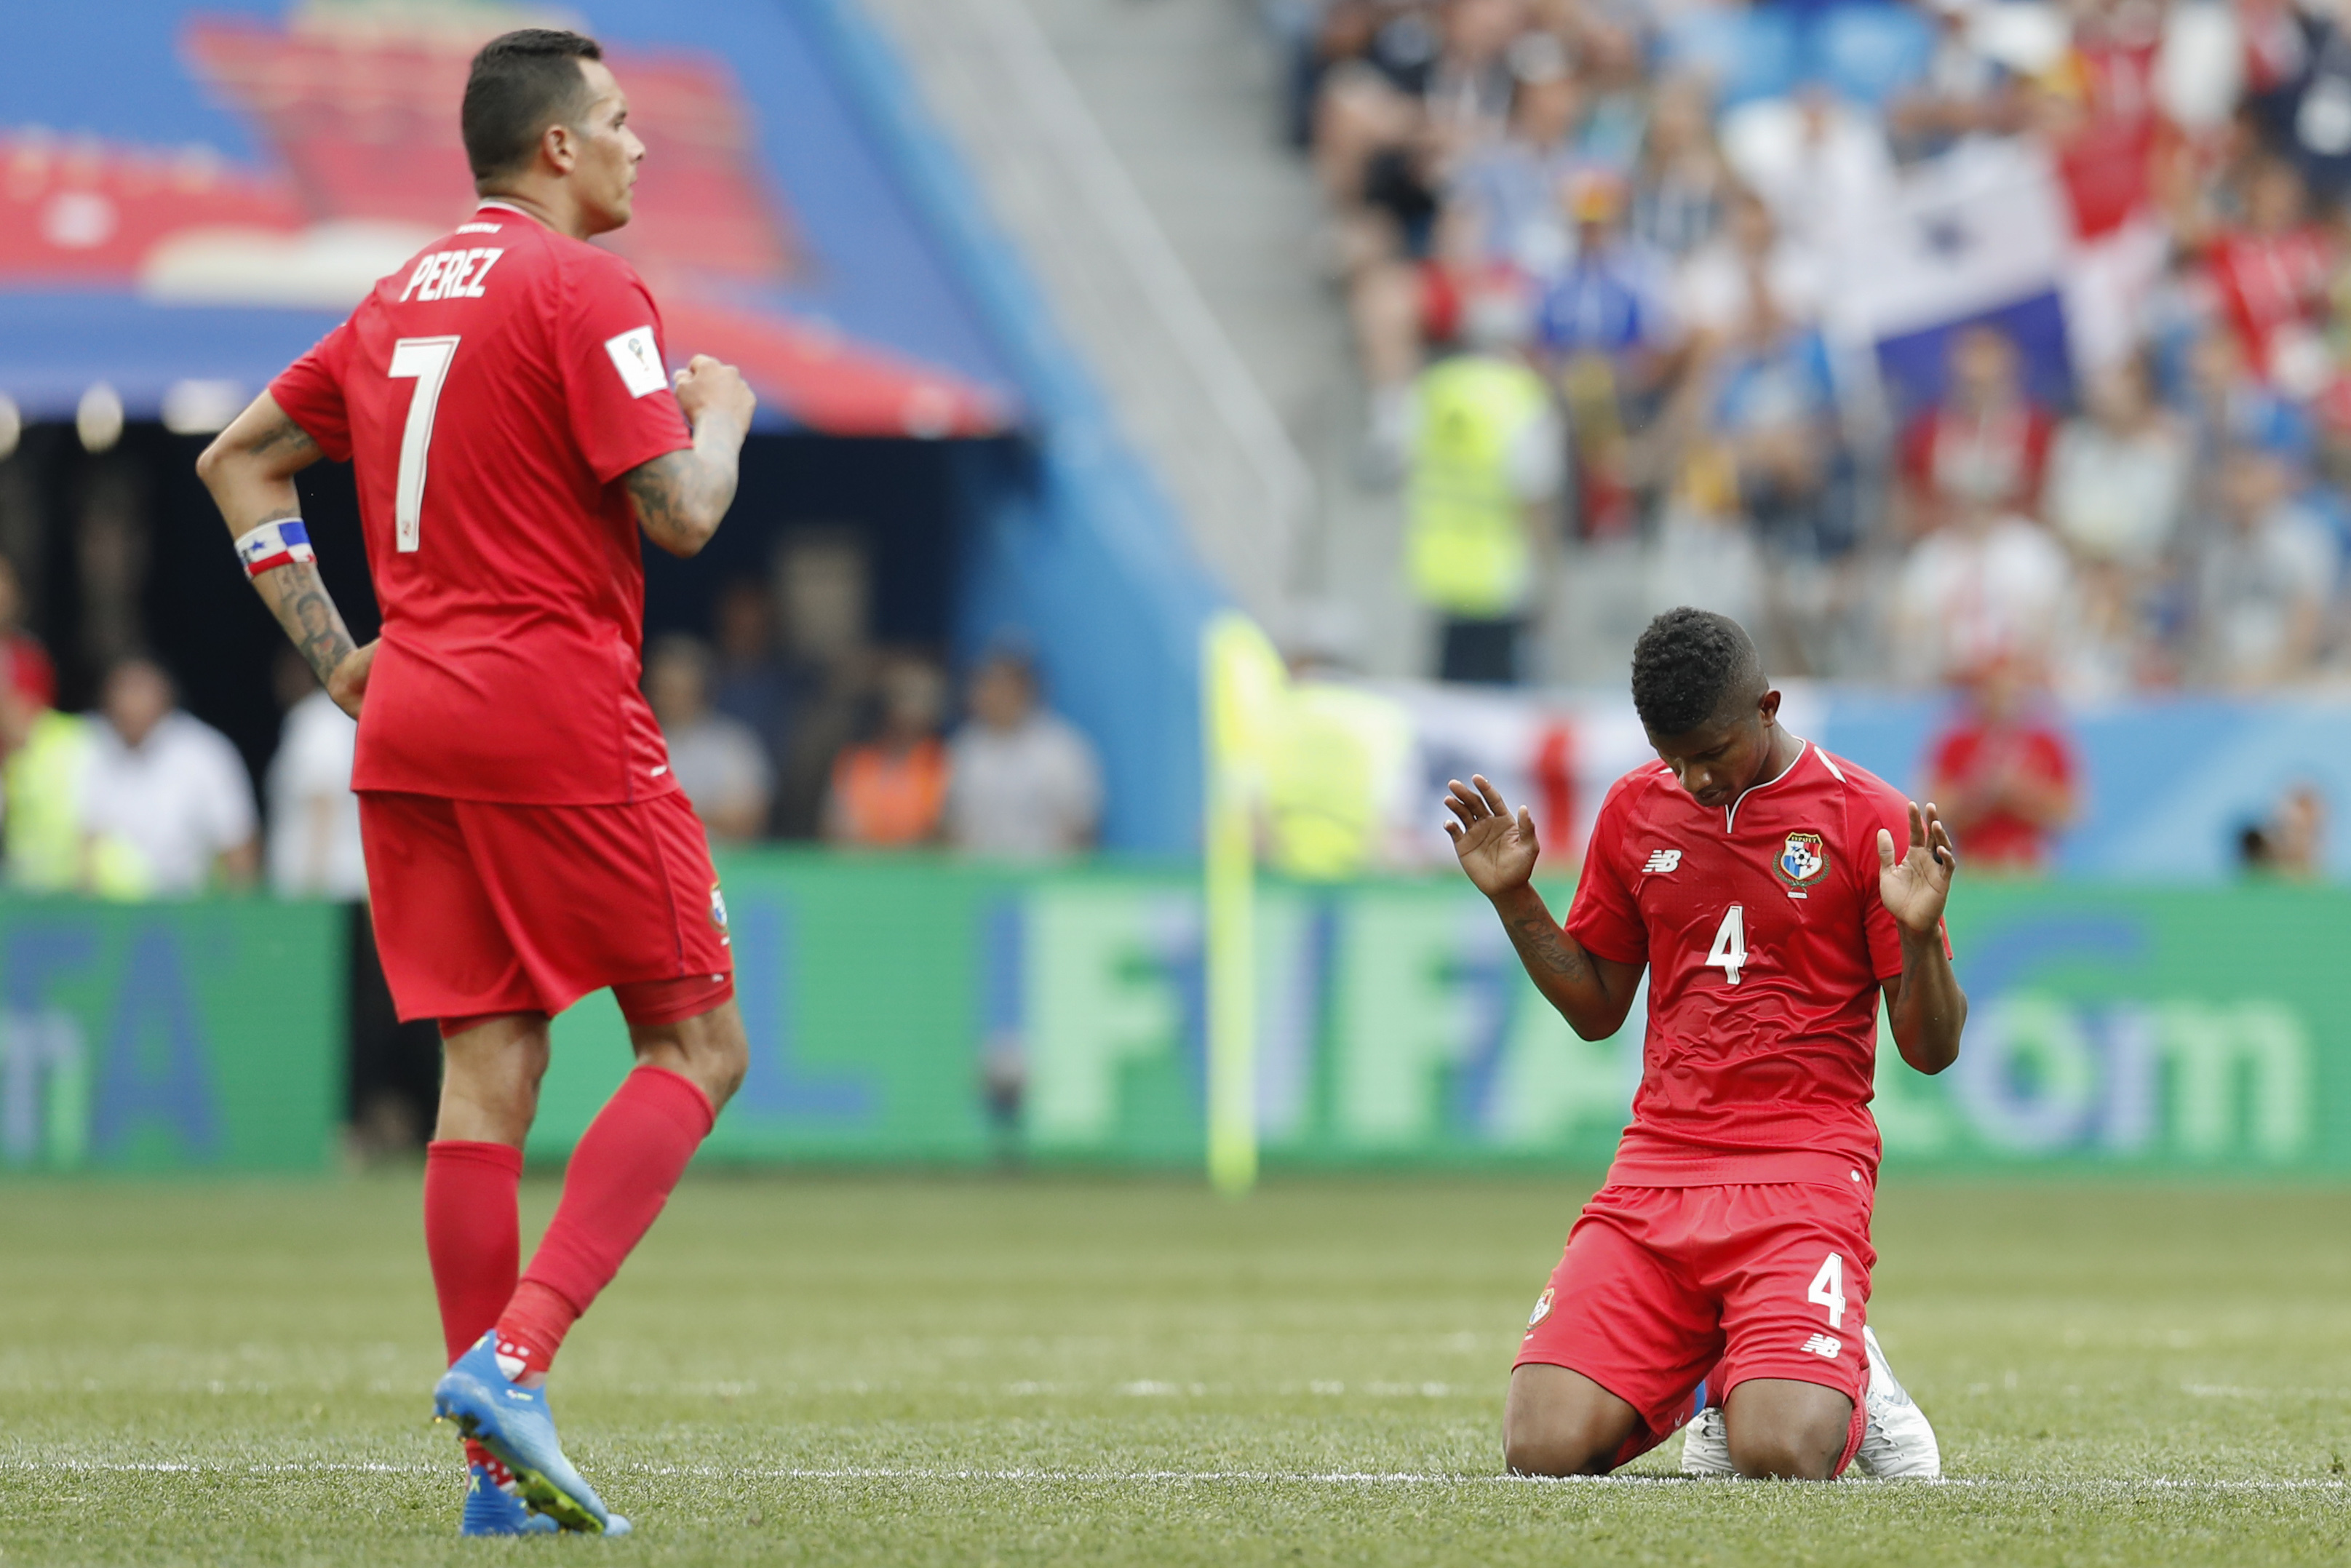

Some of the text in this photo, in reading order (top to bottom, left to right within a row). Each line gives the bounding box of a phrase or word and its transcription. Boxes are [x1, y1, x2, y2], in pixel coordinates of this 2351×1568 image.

[399, 247, 505, 303] PEREZ
[388, 334, 461, 553] 7
[1642, 849, 1682, 873] NB
[1705, 905, 1749, 985] 4
[1807, 1251, 1846, 1329] 4
[1799, 1332, 1842, 1359] NB
